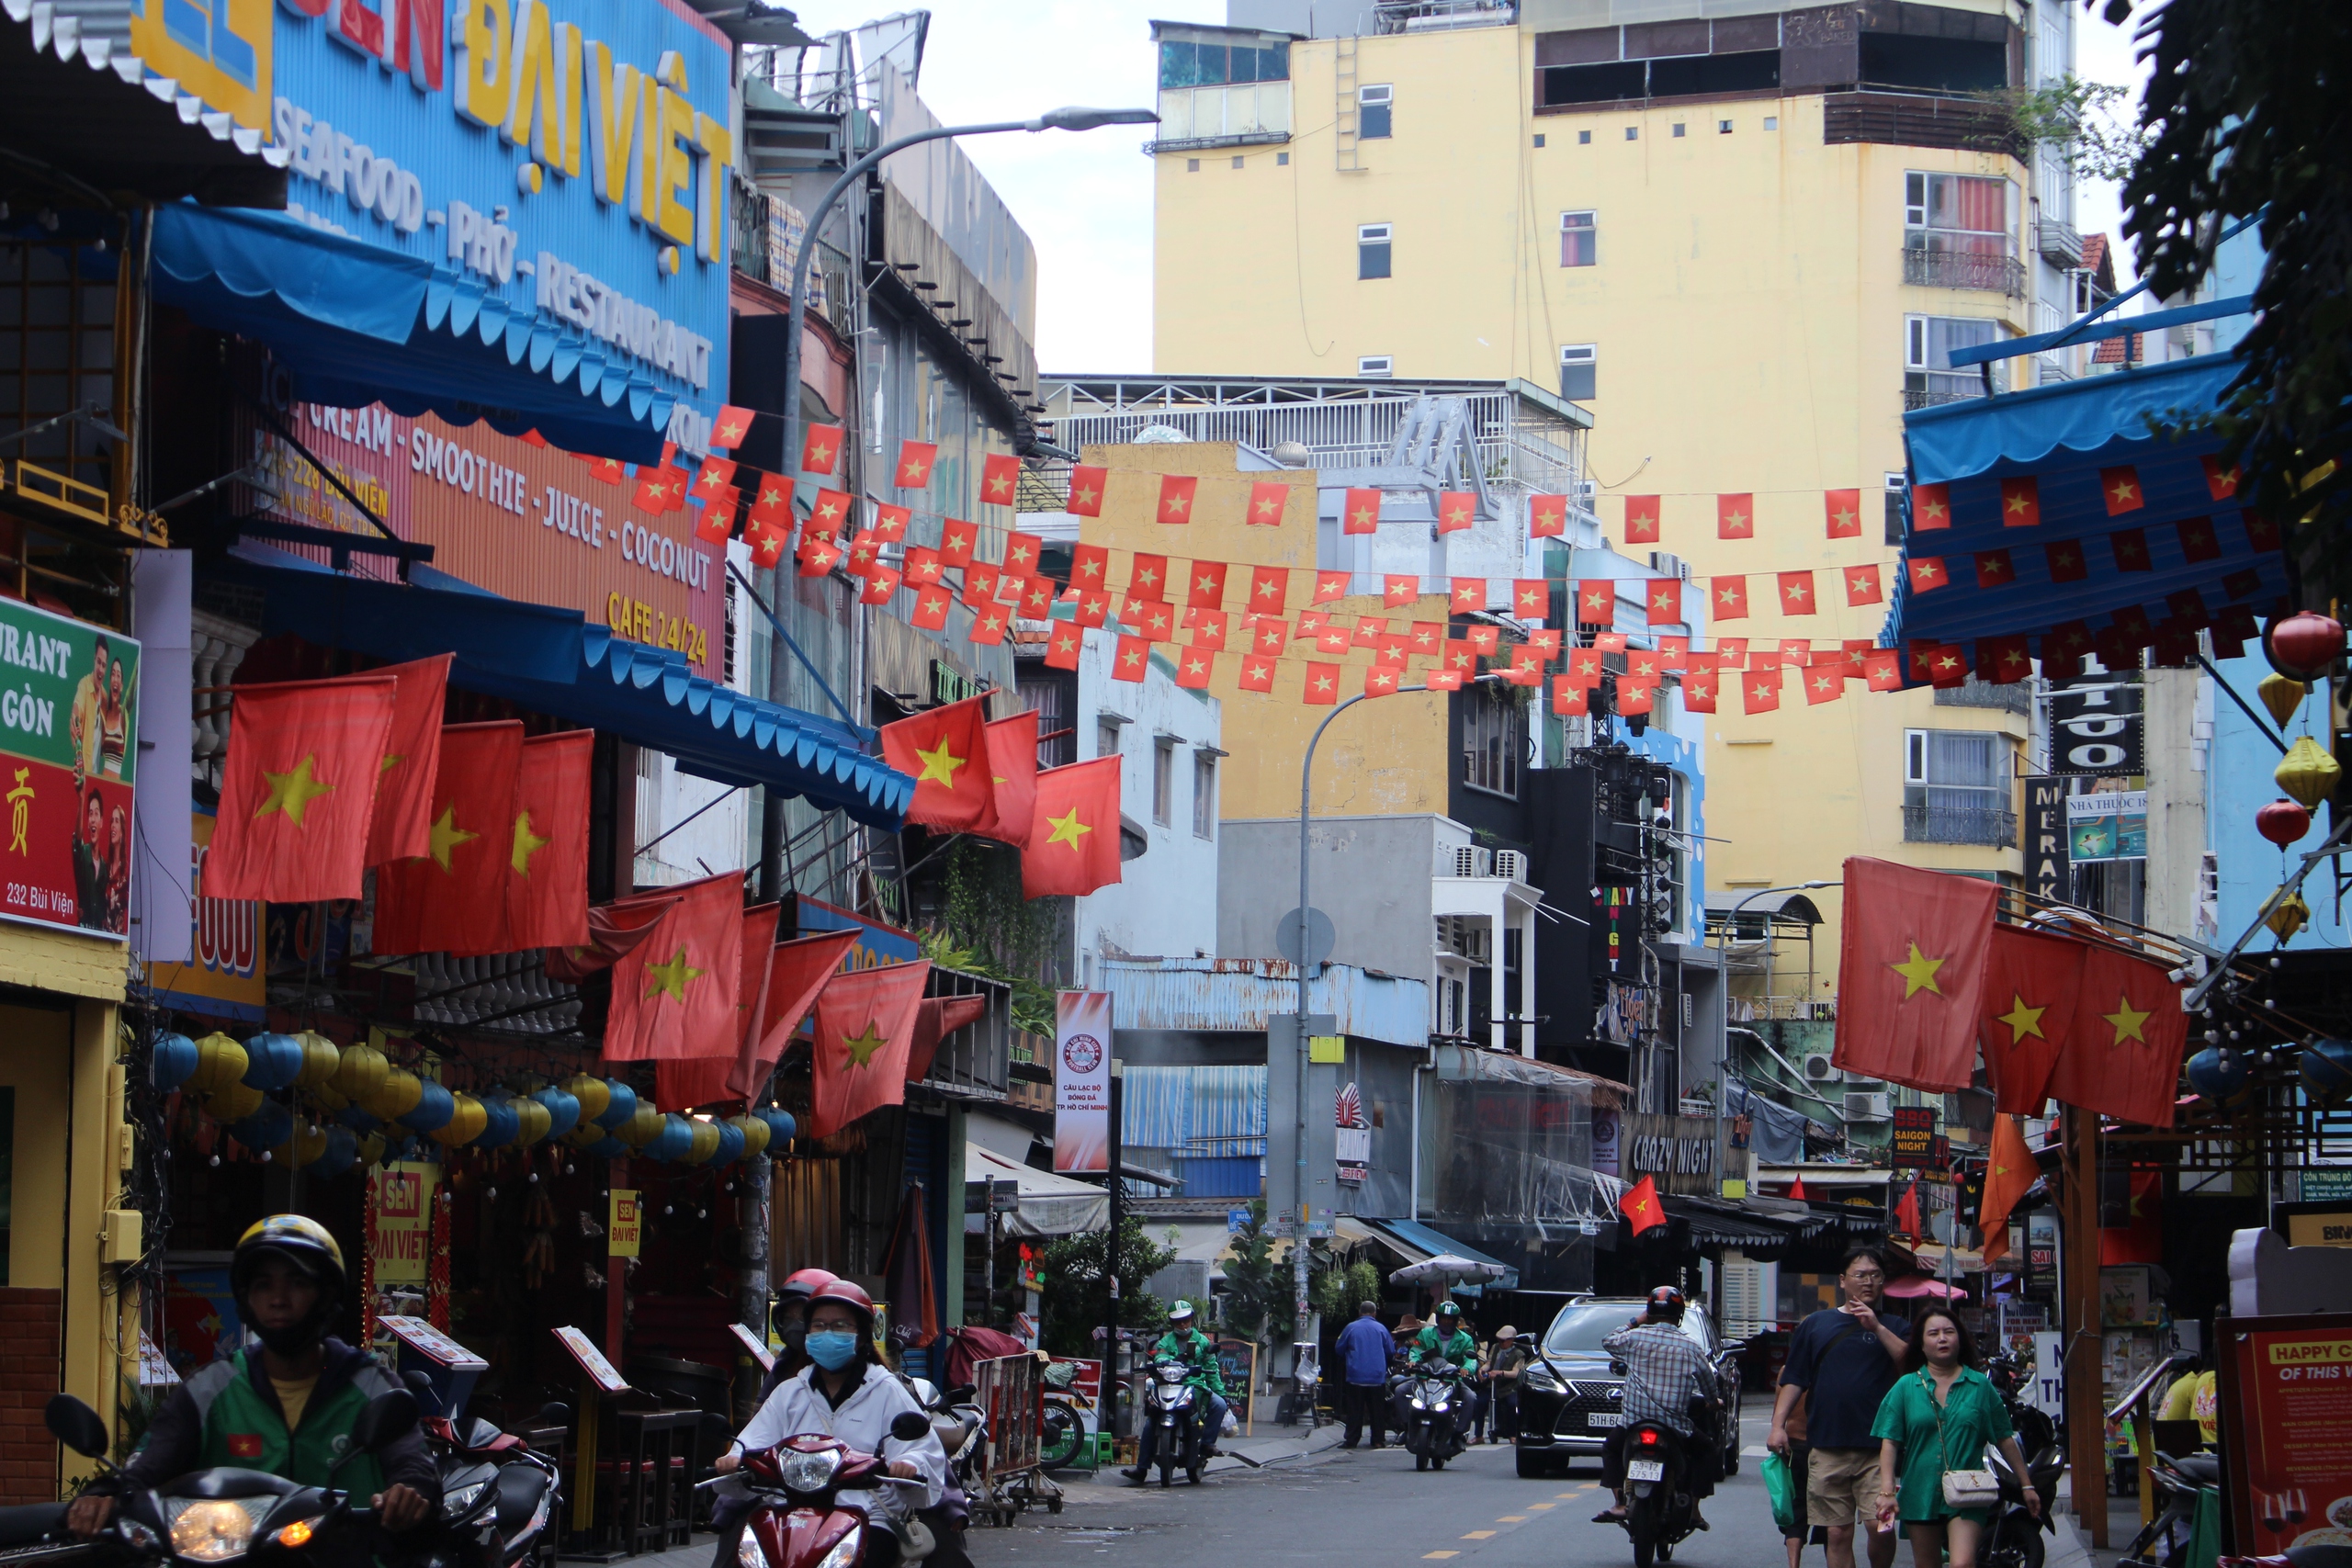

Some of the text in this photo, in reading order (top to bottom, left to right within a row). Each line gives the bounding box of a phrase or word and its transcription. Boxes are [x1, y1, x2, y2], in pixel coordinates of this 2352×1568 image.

[451, 0, 582, 195] ĐẠI
[584, 51, 731, 275] VIỆT
[276, 96, 423, 232] SEAFOOD
[447, 201, 517, 284] PHỞ
[537, 251, 713, 389] RESTAURANT
[310, 402, 391, 457] CREAM
[412, 427, 525, 515] SMOOTHIE
[543, 486, 602, 547] JUICE
[622, 521, 710, 591] COCONUT
[608, 591, 707, 665] CAFE 24/24
[2, 683, 54, 738] GÒN
[2069, 798, 2093, 811] NHÀ
[7, 882, 74, 914] 232 Bùi Viện
[1594, 886, 1634, 972] CRAZY NIGHT
[1894, 1110, 1932, 1128] BBQ
[1894, 1131, 1931, 1141] SAIGON
[1897, 1142, 1927, 1151] NIGHT
[1634, 1135, 1715, 1175] CRAZY NIGHT
[385, 1179, 415, 1211] SEN
[619, 1202, 633, 1218] SEN
[398, 1221, 430, 1269] VIỆT
[612, 1223, 639, 1246] ĐẠI VIỆT
[2276, 1345, 2332, 1359] HAPPY
[2279, 1368, 2301, 1380] OF
[2306, 1366, 2340, 1379] THIS
[1630, 1470, 1659, 1480] 575.13
[1634, 1461, 1658, 1471] 59-T2
